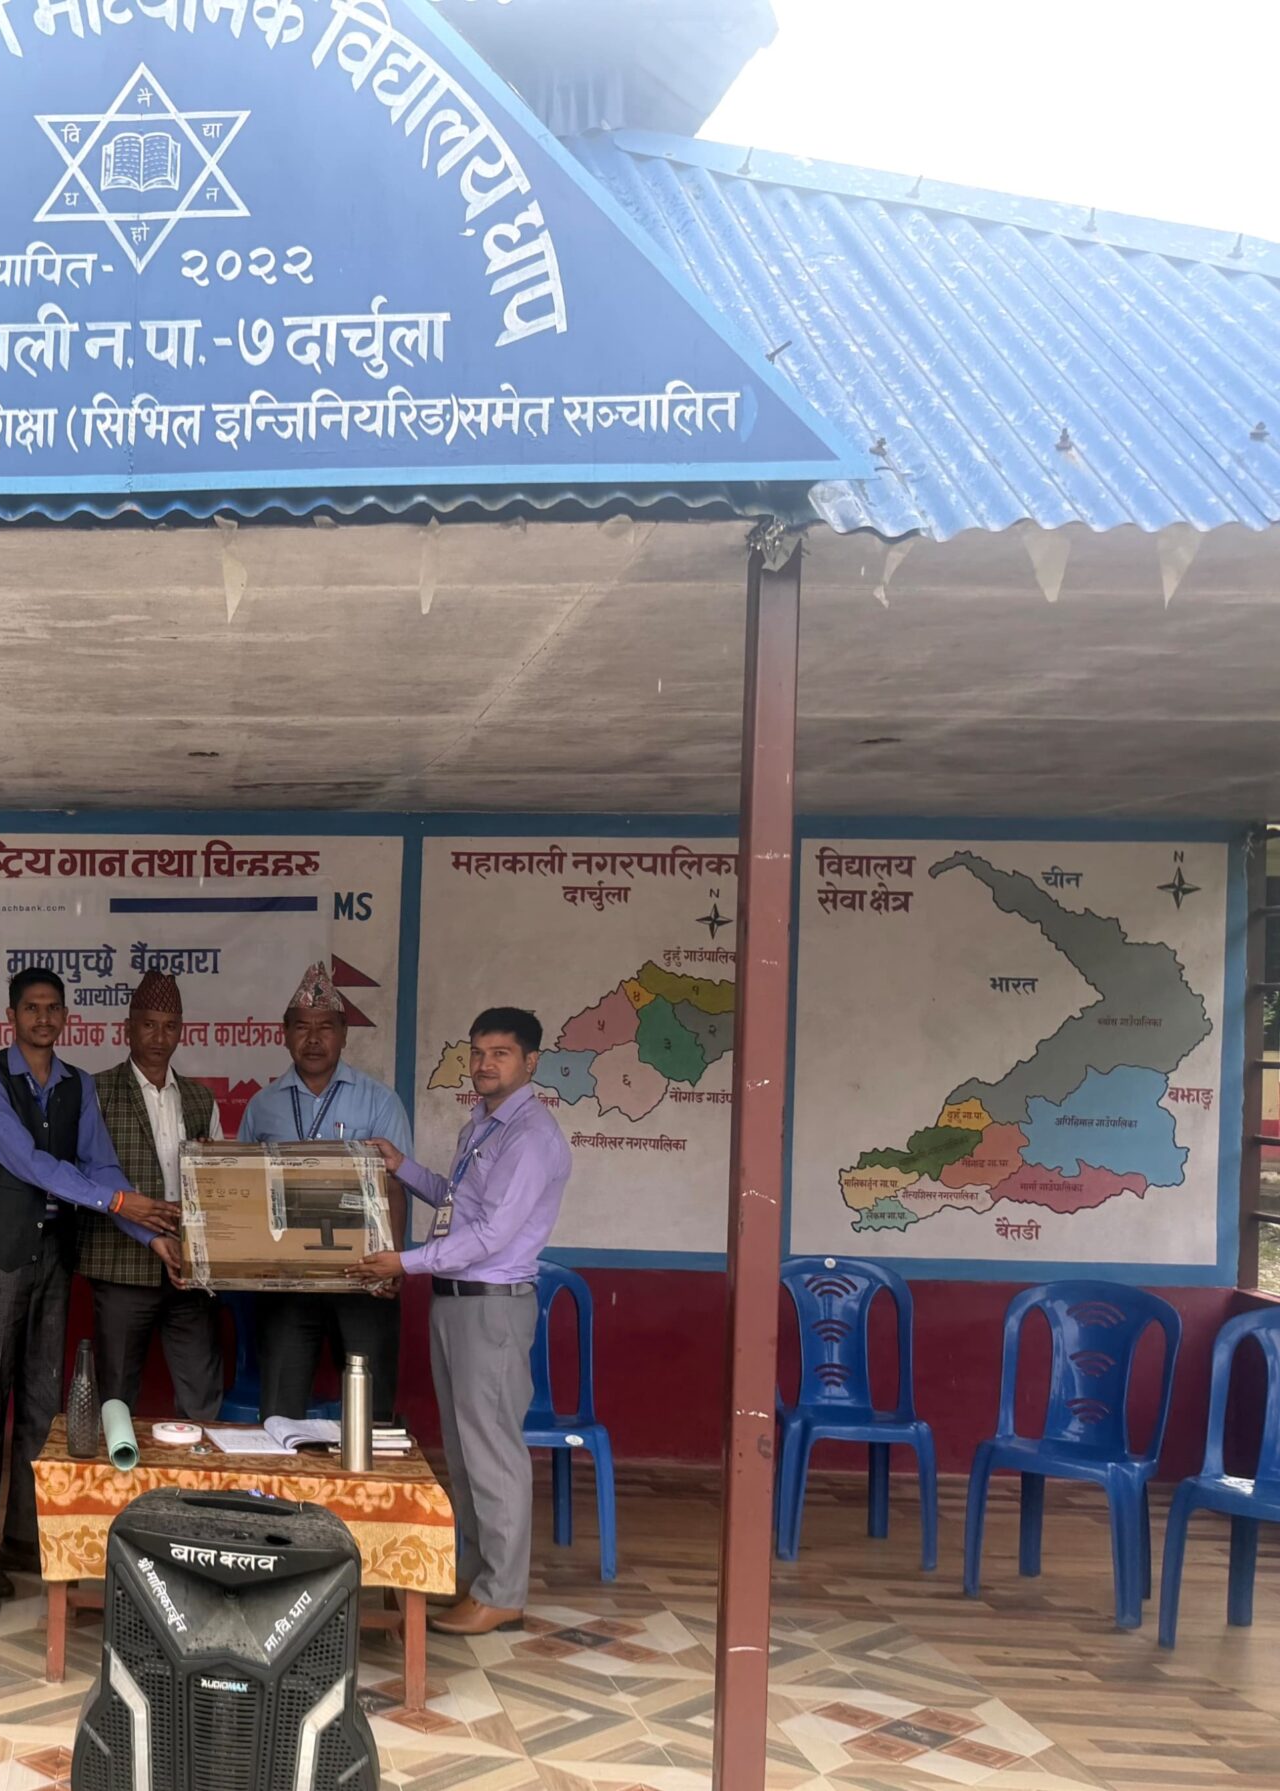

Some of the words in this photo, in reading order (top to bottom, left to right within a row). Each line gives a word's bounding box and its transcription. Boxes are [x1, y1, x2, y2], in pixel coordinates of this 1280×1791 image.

[61, 122, 82, 144] वि
[202, 122, 223, 139] द्या
[130, 221, 150, 246] हो
[180, 246, 314, 288] २०२२
[282, 296, 452, 379] दार्चुला
[562, 380, 741, 437] सञ्चालित
[59, 848, 129, 877] गान
[131, 848, 197, 877] तथा
[451, 844, 567, 880] महाकाली
[572, 844, 739, 880] नगरपालिका
[815, 846, 917, 881] विद्यालय
[1173, 851, 1183, 863] N
[1042, 866, 1083, 889] चीन
[562, 880, 632, 911] दार्चुला
[709, 888, 720, 899] N
[817, 882, 868, 915] सेवा
[870, 882, 914, 915] क्षेत्र
[683, 946, 737, 964] गाउँपालिक
[74, 982, 136, 1007] आयोजि
[990, 976, 1039, 995] भारत
[560, 1066, 570, 1078] ७
[622, 1073, 632, 1088] ६
[625, 1134, 688, 1152] नगरपालिका
[995, 1216, 1042, 1241] बैतडी
[170, 1542, 218, 1567] बाल
[200, 1677, 249, 1693] AUDIOMAX
